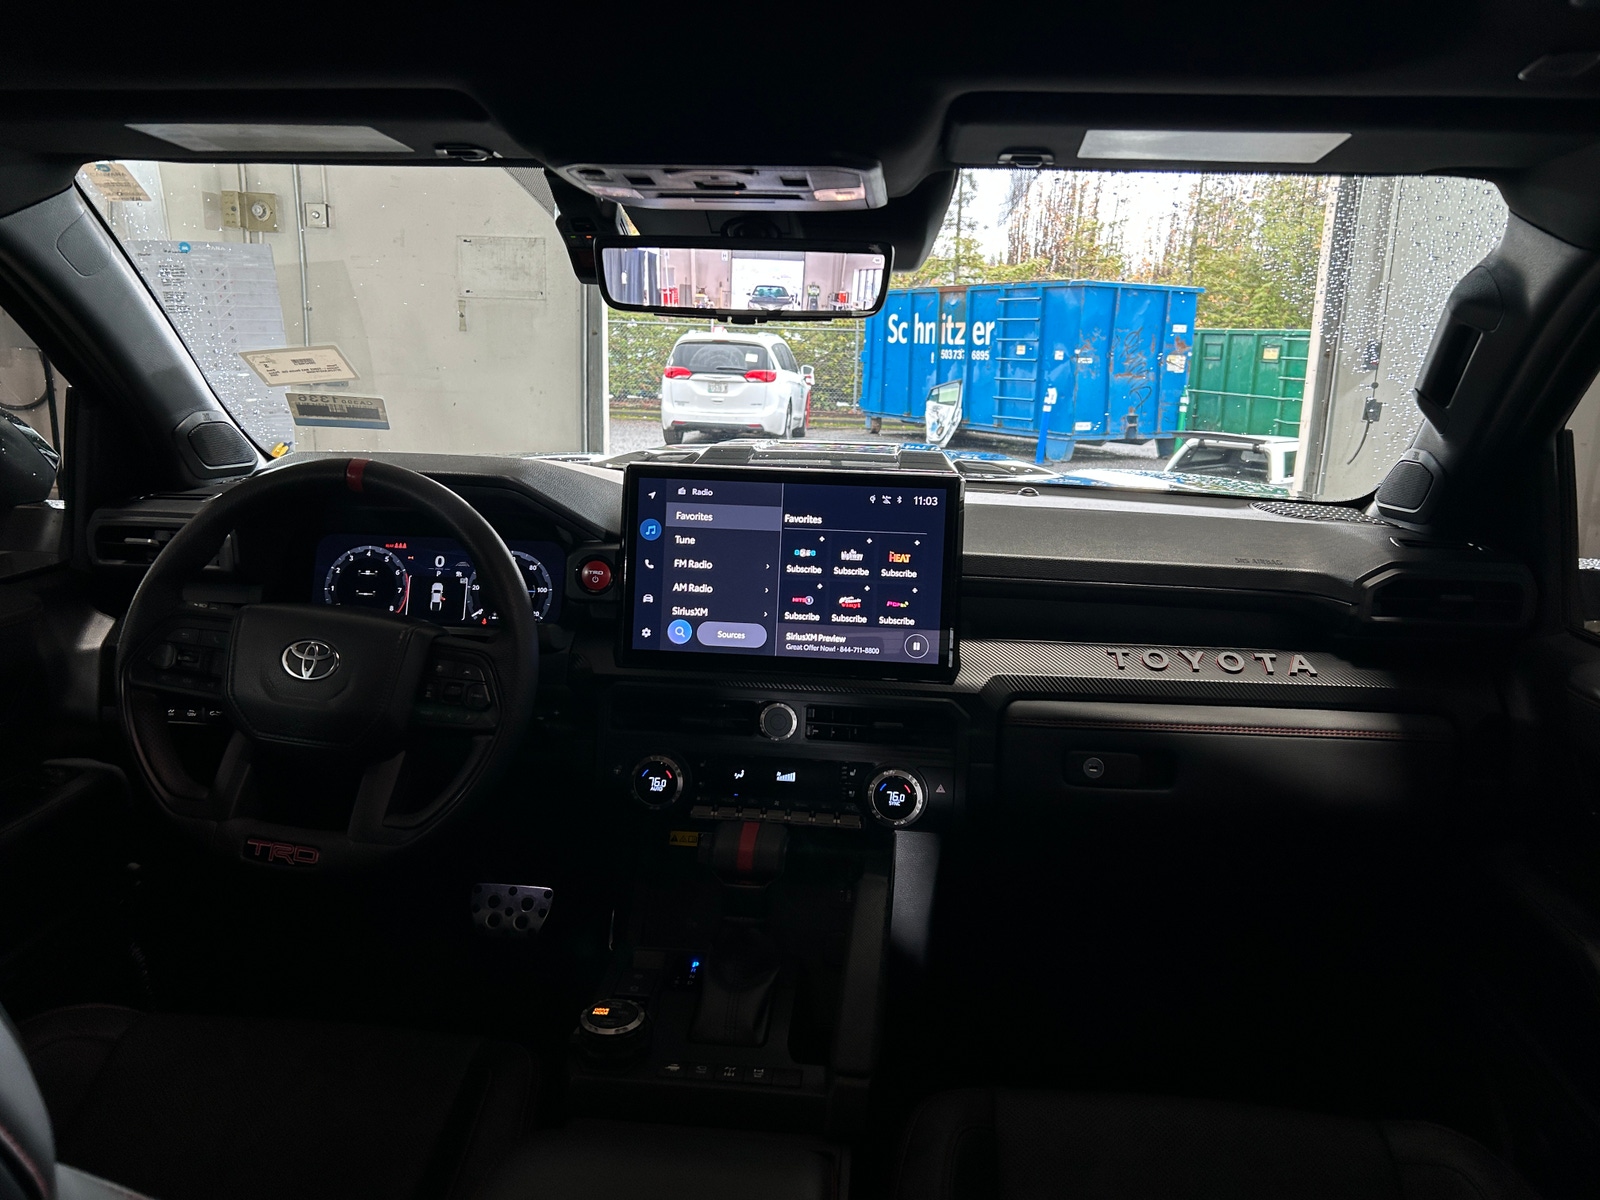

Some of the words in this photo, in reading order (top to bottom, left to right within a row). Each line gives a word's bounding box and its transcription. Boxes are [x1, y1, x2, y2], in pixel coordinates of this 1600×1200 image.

[887, 312, 996, 346] Schnitzer
[692, 488, 713, 496] Radio
[913, 496, 938, 506] 11:03
[676, 511, 713, 522] Favorites
[784, 514, 823, 525] Favorites
[675, 536, 695, 544] Tune
[434, 555, 445, 568] 0
[674, 560, 687, 569] FM
[689, 560, 713, 570] Radio
[786, 565, 822, 575] Subscribe
[834, 567, 869, 577] Subscribe
[881, 569, 917, 579] Subscribe
[673, 584, 689, 593] AM
[690, 584, 713, 594] Radio
[672, 607, 708, 617] SiriusXM
[784, 612, 820, 622] Subscribe
[832, 614, 867, 624] Subscribe
[879, 616, 915, 626] Subscribe
[717, 630, 746, 640] Sources
[786, 632, 818, 642] SiriusXM
[818, 634, 847, 643] Preview
[840, 646, 880, 654] 844-711-8800
[1107, 648, 1318, 677] TOYOTA
[247, 838, 320, 865] TRD
